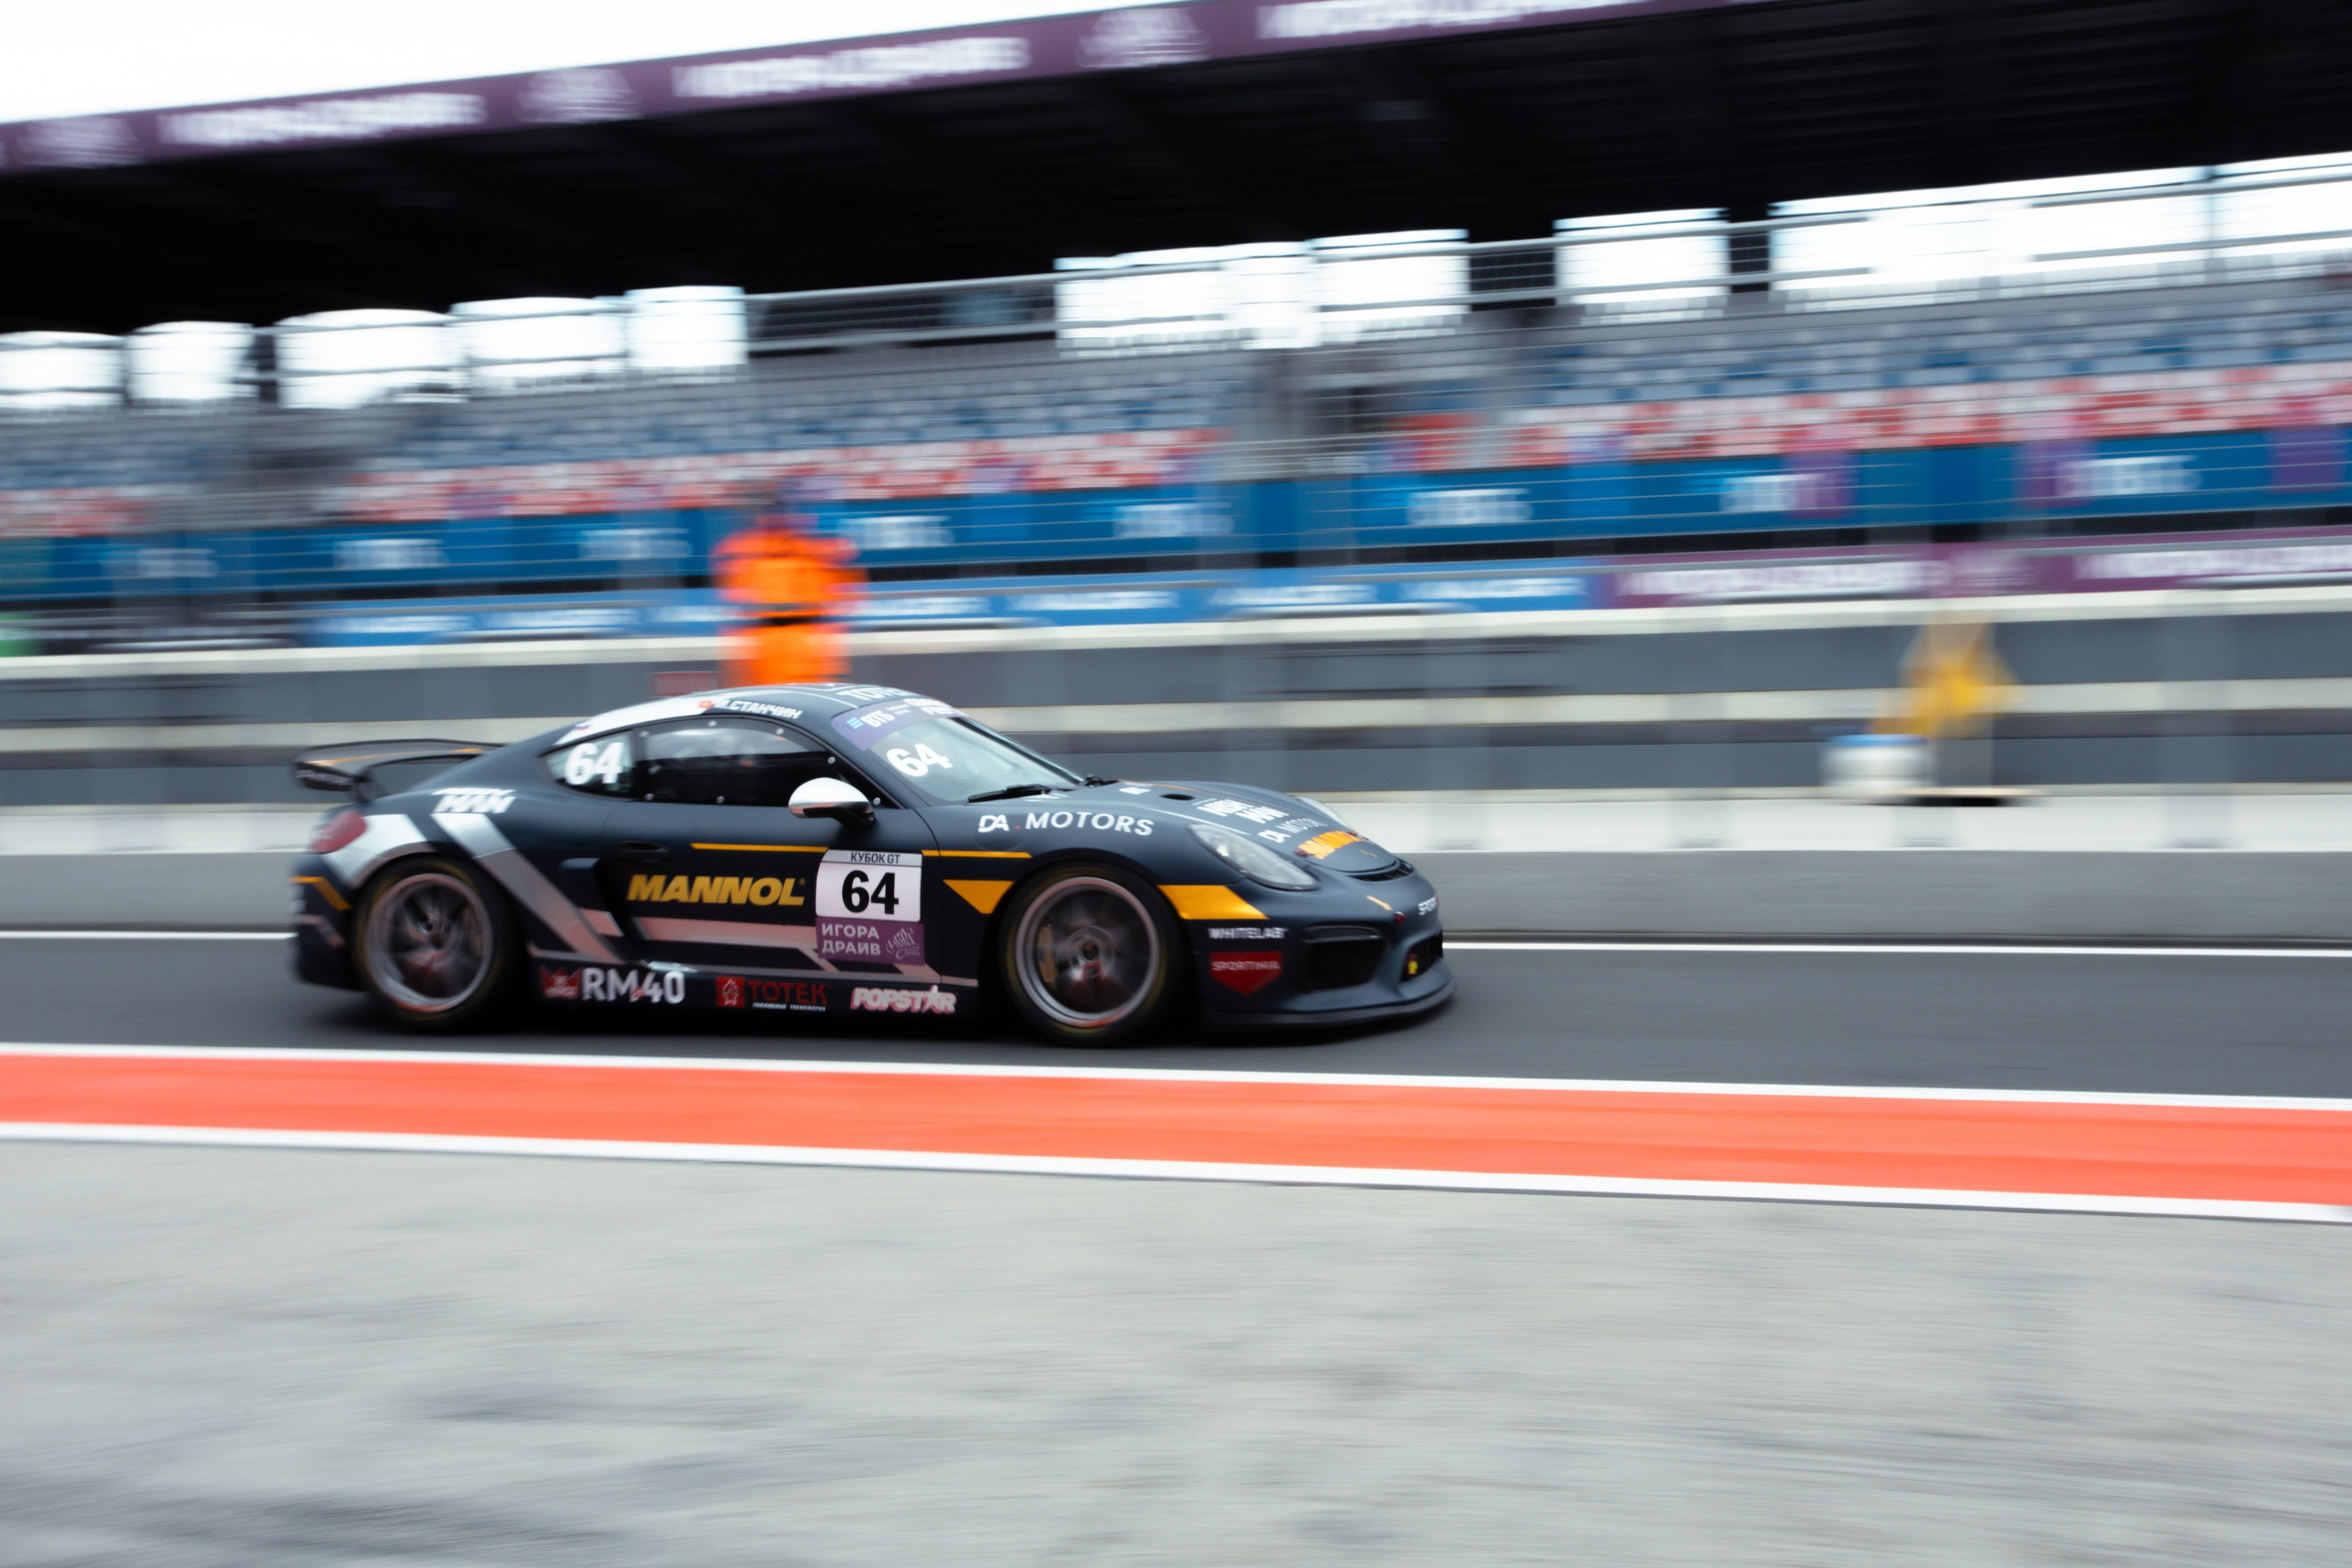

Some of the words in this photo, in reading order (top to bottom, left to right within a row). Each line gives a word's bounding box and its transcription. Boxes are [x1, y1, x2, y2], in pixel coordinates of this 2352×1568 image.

[860, 709, 896, 728] ВТБ
[564, 742, 625, 784] 64
[887, 743, 954, 777] 64
[1025, 812, 1155, 836] MOTORS
[851, 852, 886, 863] КУБОК
[888, 854, 901, 864] GT
[842, 870, 899, 915] 64
[821, 923, 879, 939] ИГОРА
[850, 985, 956, 1014] POPSTAR
